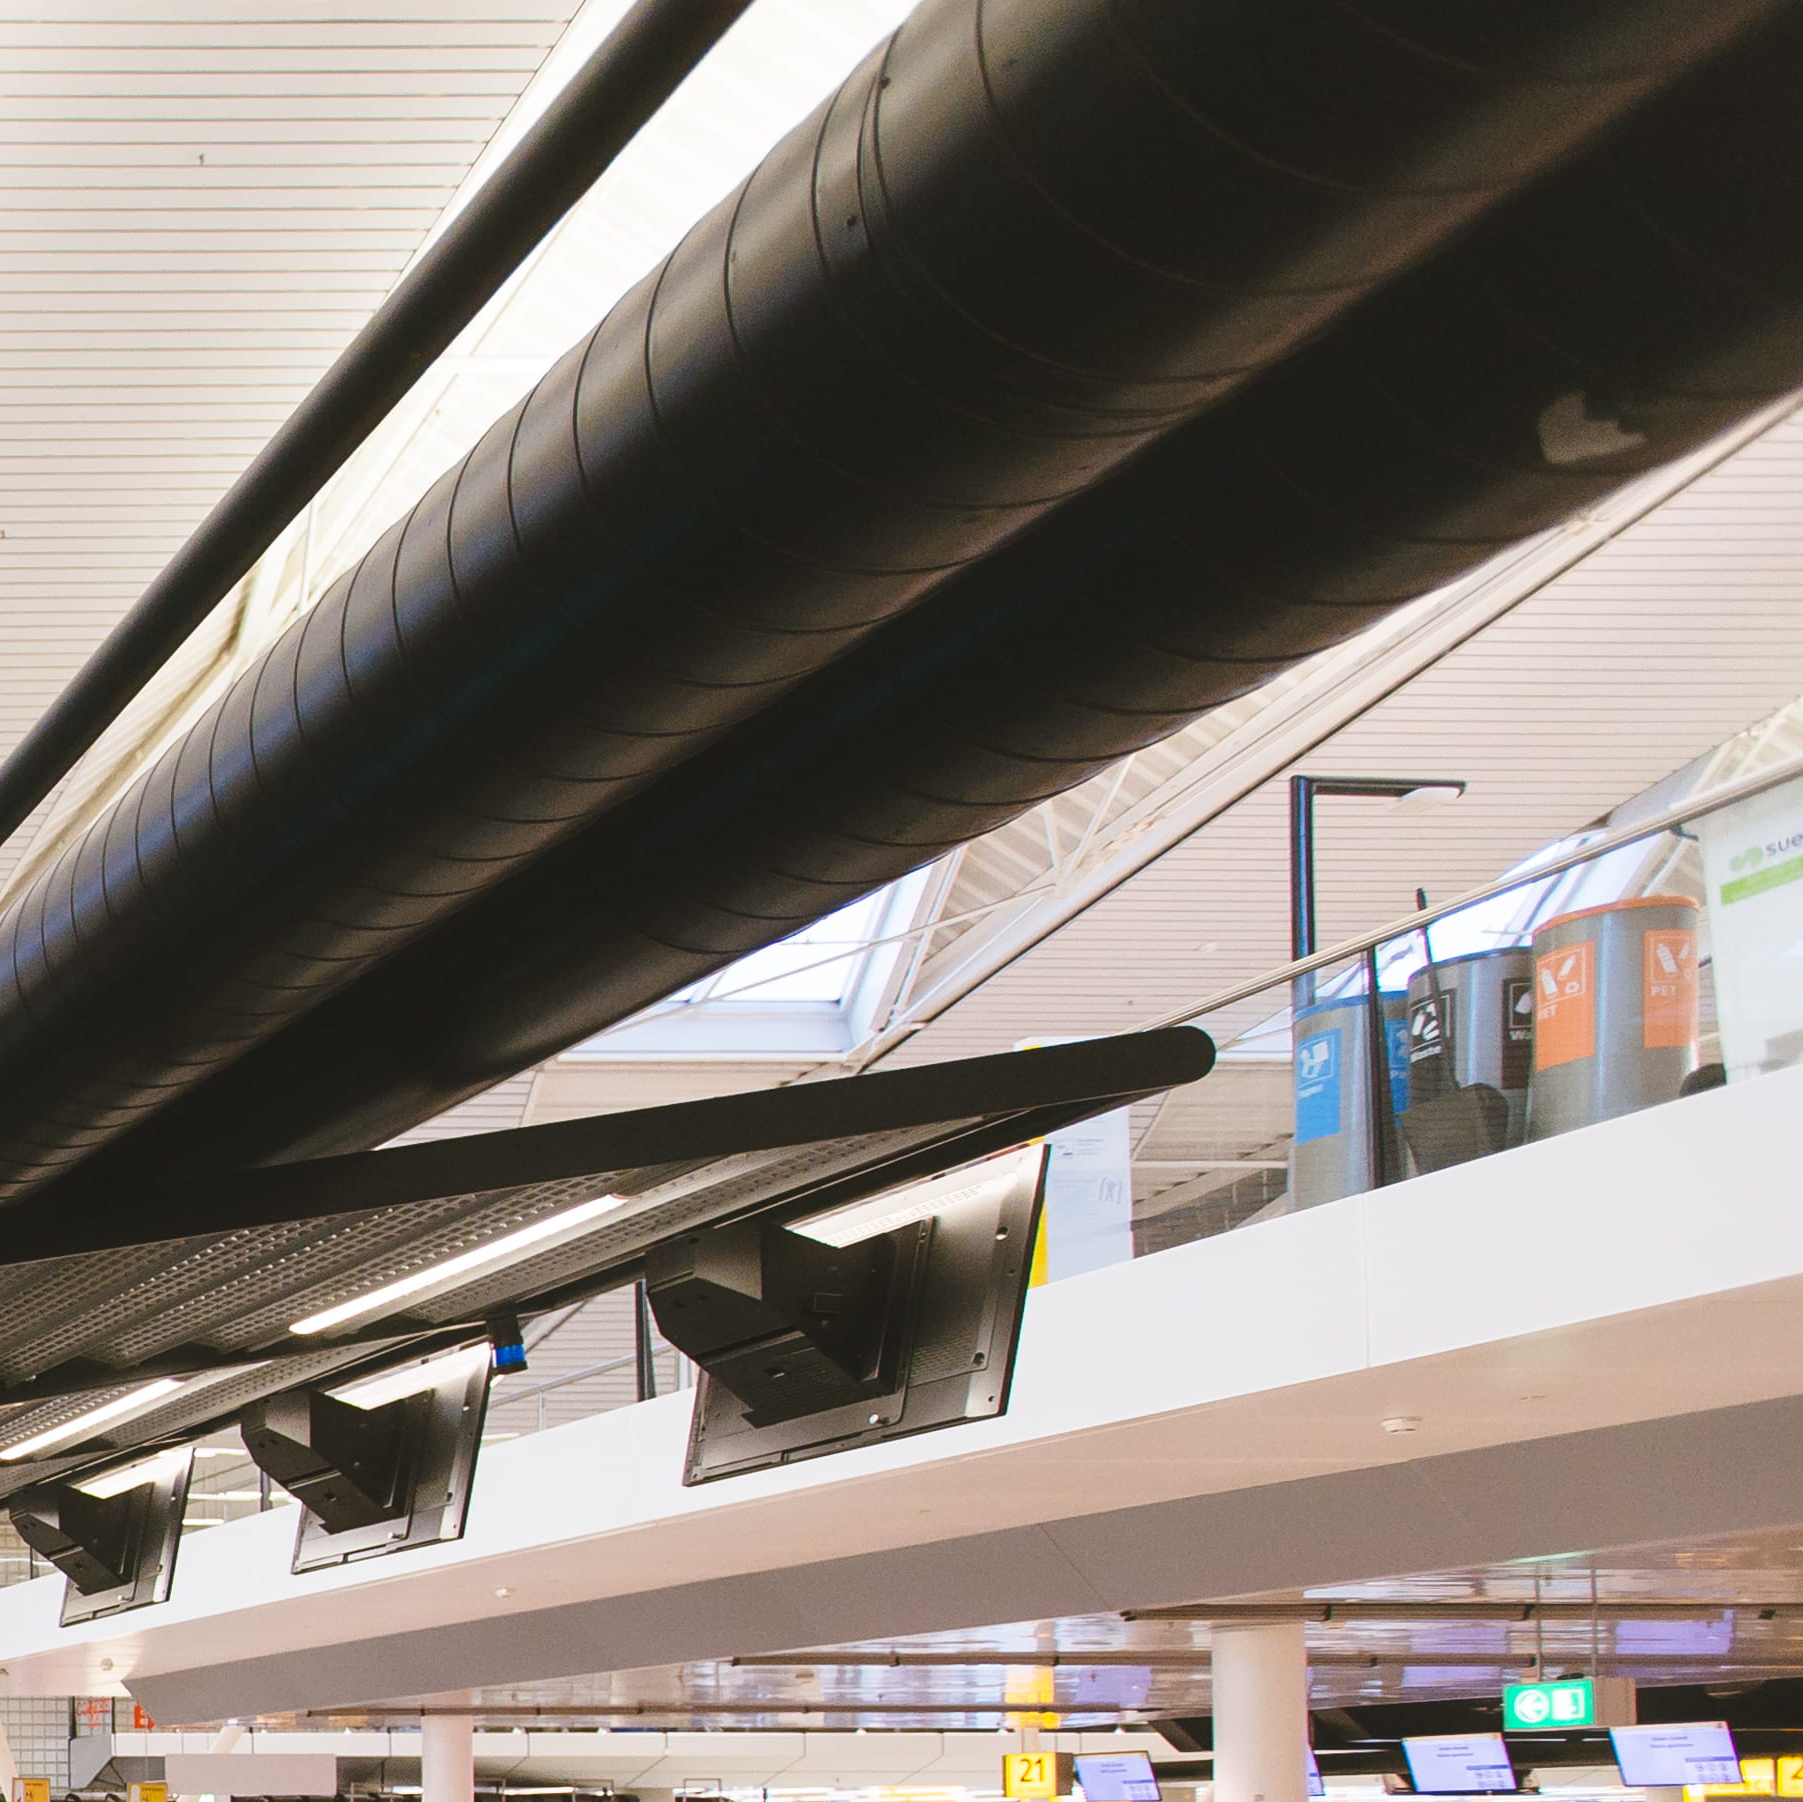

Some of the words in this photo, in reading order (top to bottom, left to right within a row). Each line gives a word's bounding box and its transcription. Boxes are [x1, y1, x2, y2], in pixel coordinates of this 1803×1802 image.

[1765, 833, 1803, 857] sue
[1650, 984, 1676, 997] PET
[1019, 1757, 1046, 1783] 21
